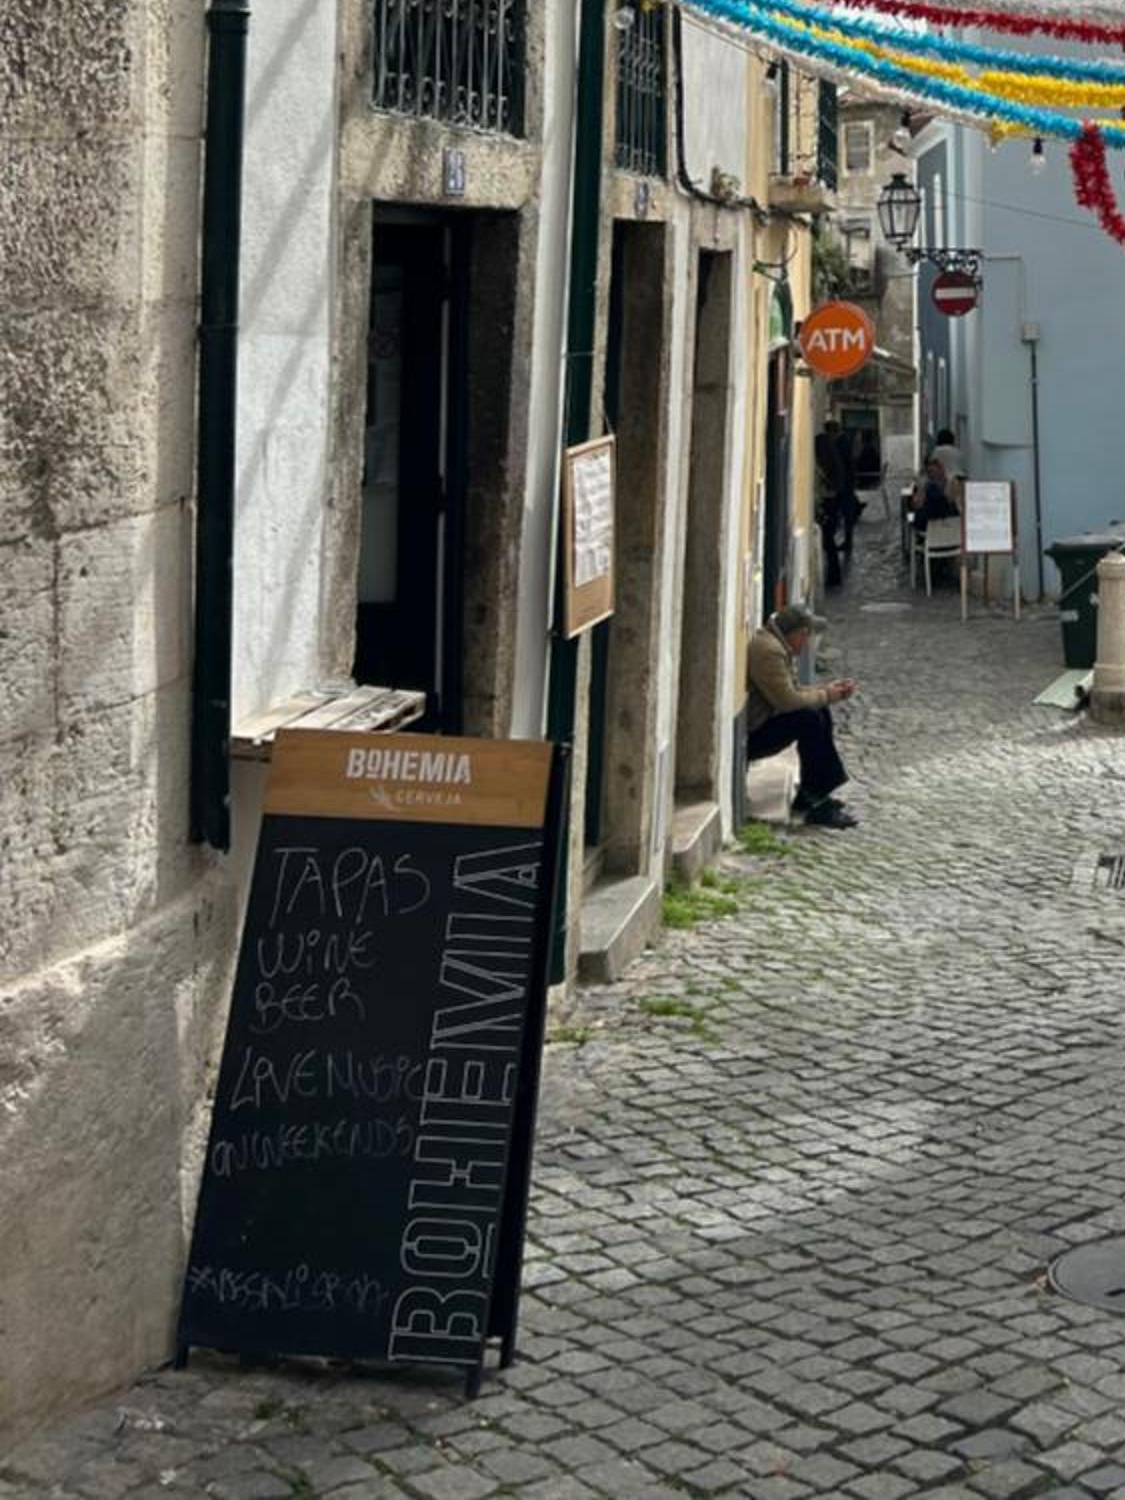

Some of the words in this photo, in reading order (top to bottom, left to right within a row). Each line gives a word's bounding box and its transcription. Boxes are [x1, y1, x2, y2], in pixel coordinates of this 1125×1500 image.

[806, 327, 865, 353] ATM
[345, 747, 472, 785] BOHEMIA
[268, 847, 431, 928] TAPAS
[250, 978, 365, 1033] BEER
[387, 841, 544, 1367] BOHEMIA
